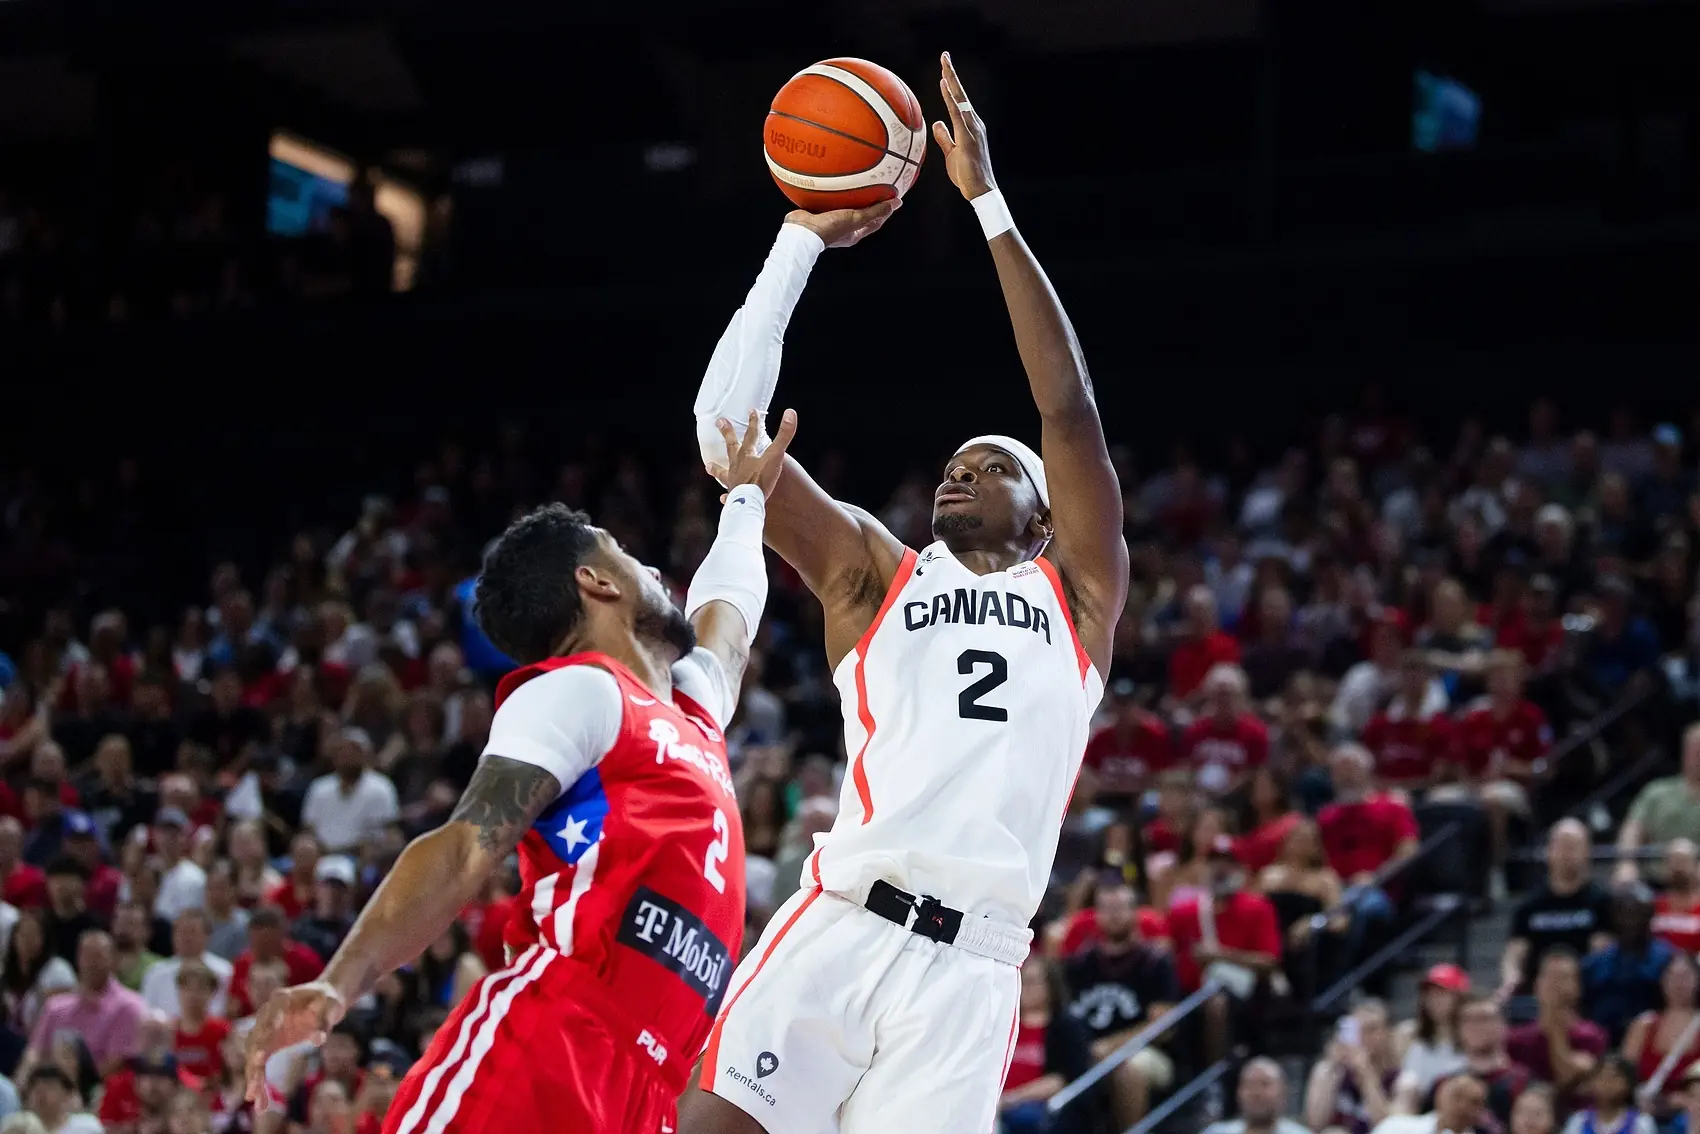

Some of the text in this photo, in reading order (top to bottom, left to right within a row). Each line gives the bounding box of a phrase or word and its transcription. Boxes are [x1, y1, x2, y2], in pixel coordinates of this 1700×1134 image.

[770, 130, 826, 159] molten
[904, 588, 1052, 646] CANADA
[957, 649, 1008, 722] 2
[704, 808, 729, 895] 2
[636, 1029, 668, 1066] PUR
[726, 1066, 776, 1106] Rentals.ca
